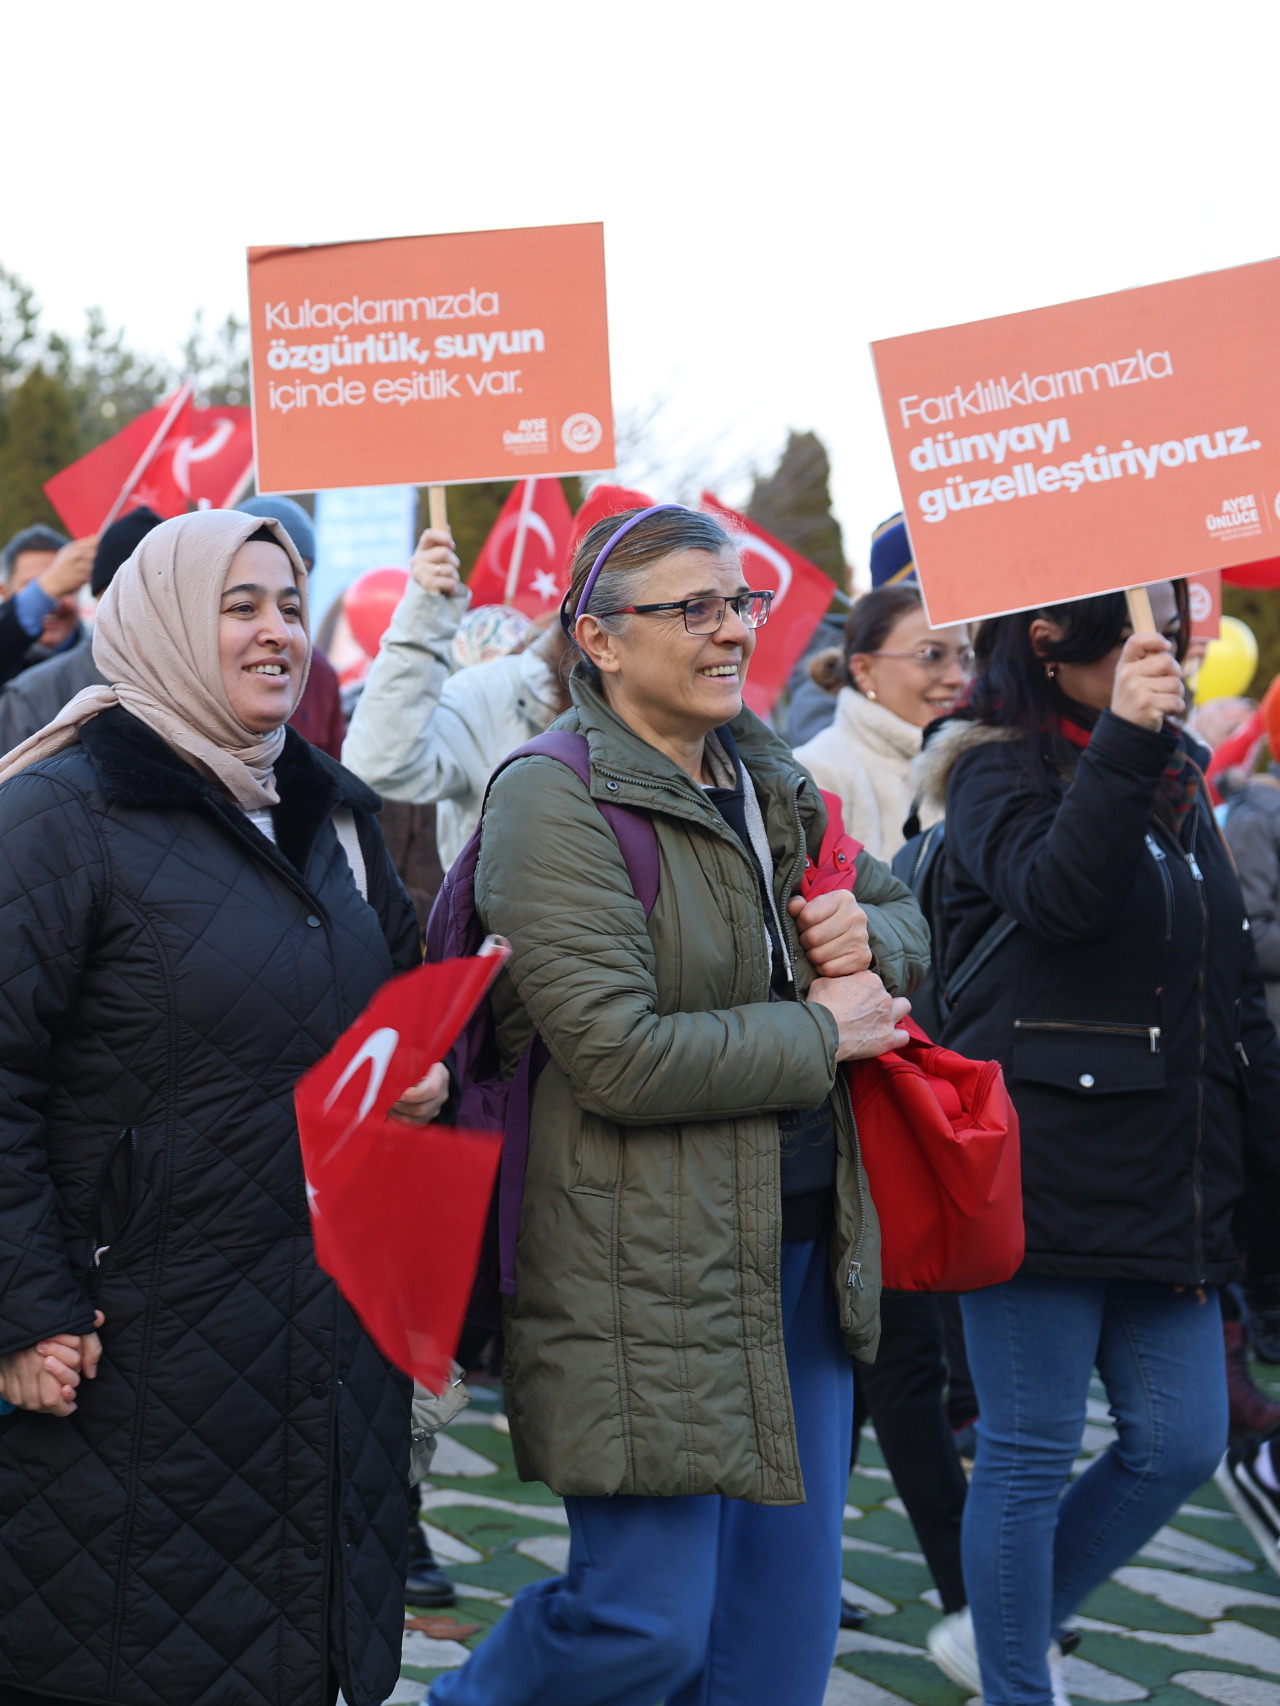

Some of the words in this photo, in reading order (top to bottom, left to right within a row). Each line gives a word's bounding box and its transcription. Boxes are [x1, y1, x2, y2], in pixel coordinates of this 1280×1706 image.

[265, 287, 499, 331] Kulaçlarımızda
[267, 331, 430, 374] özgürlük,
[434, 328, 545, 364] suyun
[269, 376, 367, 414] içinde
[373, 369, 462, 407] eşitlik
[466, 369, 523, 397] var.
[899, 348, 1173, 429] Farklılıklarımızla
[909, 417, 1071, 472] dünyayı
[918, 426, 1262, 523] güzelleştiriyoruz.
[1206, 508, 1260, 531] ÜNLÜCE
